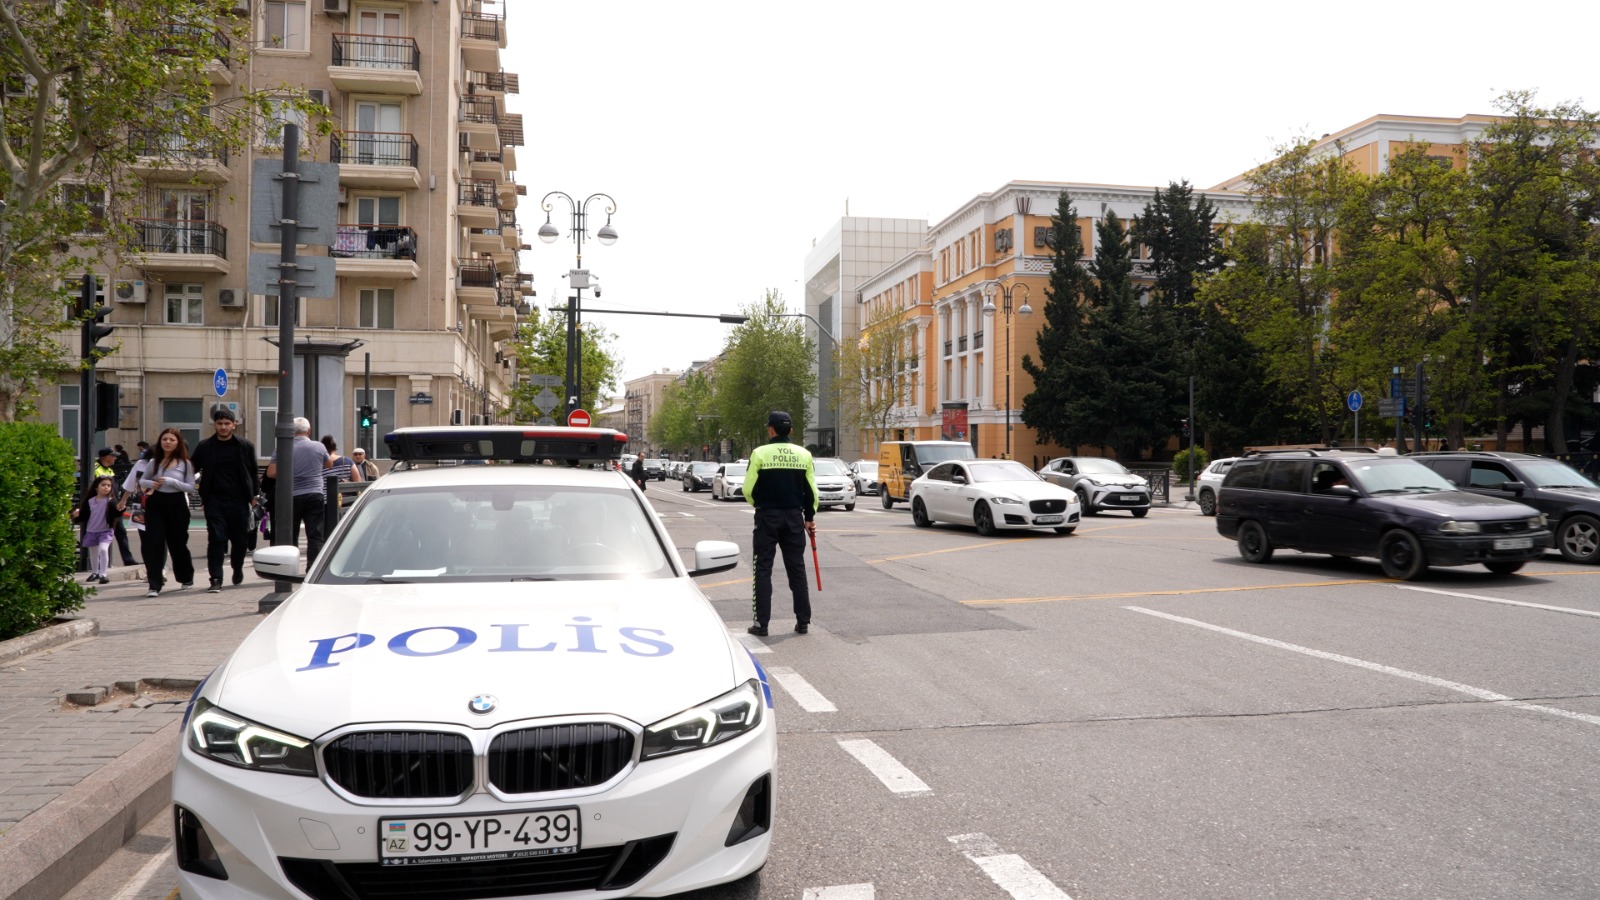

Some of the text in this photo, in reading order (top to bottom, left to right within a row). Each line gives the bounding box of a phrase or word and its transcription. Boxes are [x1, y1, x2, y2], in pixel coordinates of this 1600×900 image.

[295, 615, 675, 672] POLİS
[389, 838, 405, 850] AZ
[413, 813, 571, 852] 99-YP-439
[461, 853, 486, 861] IMPROTEX
